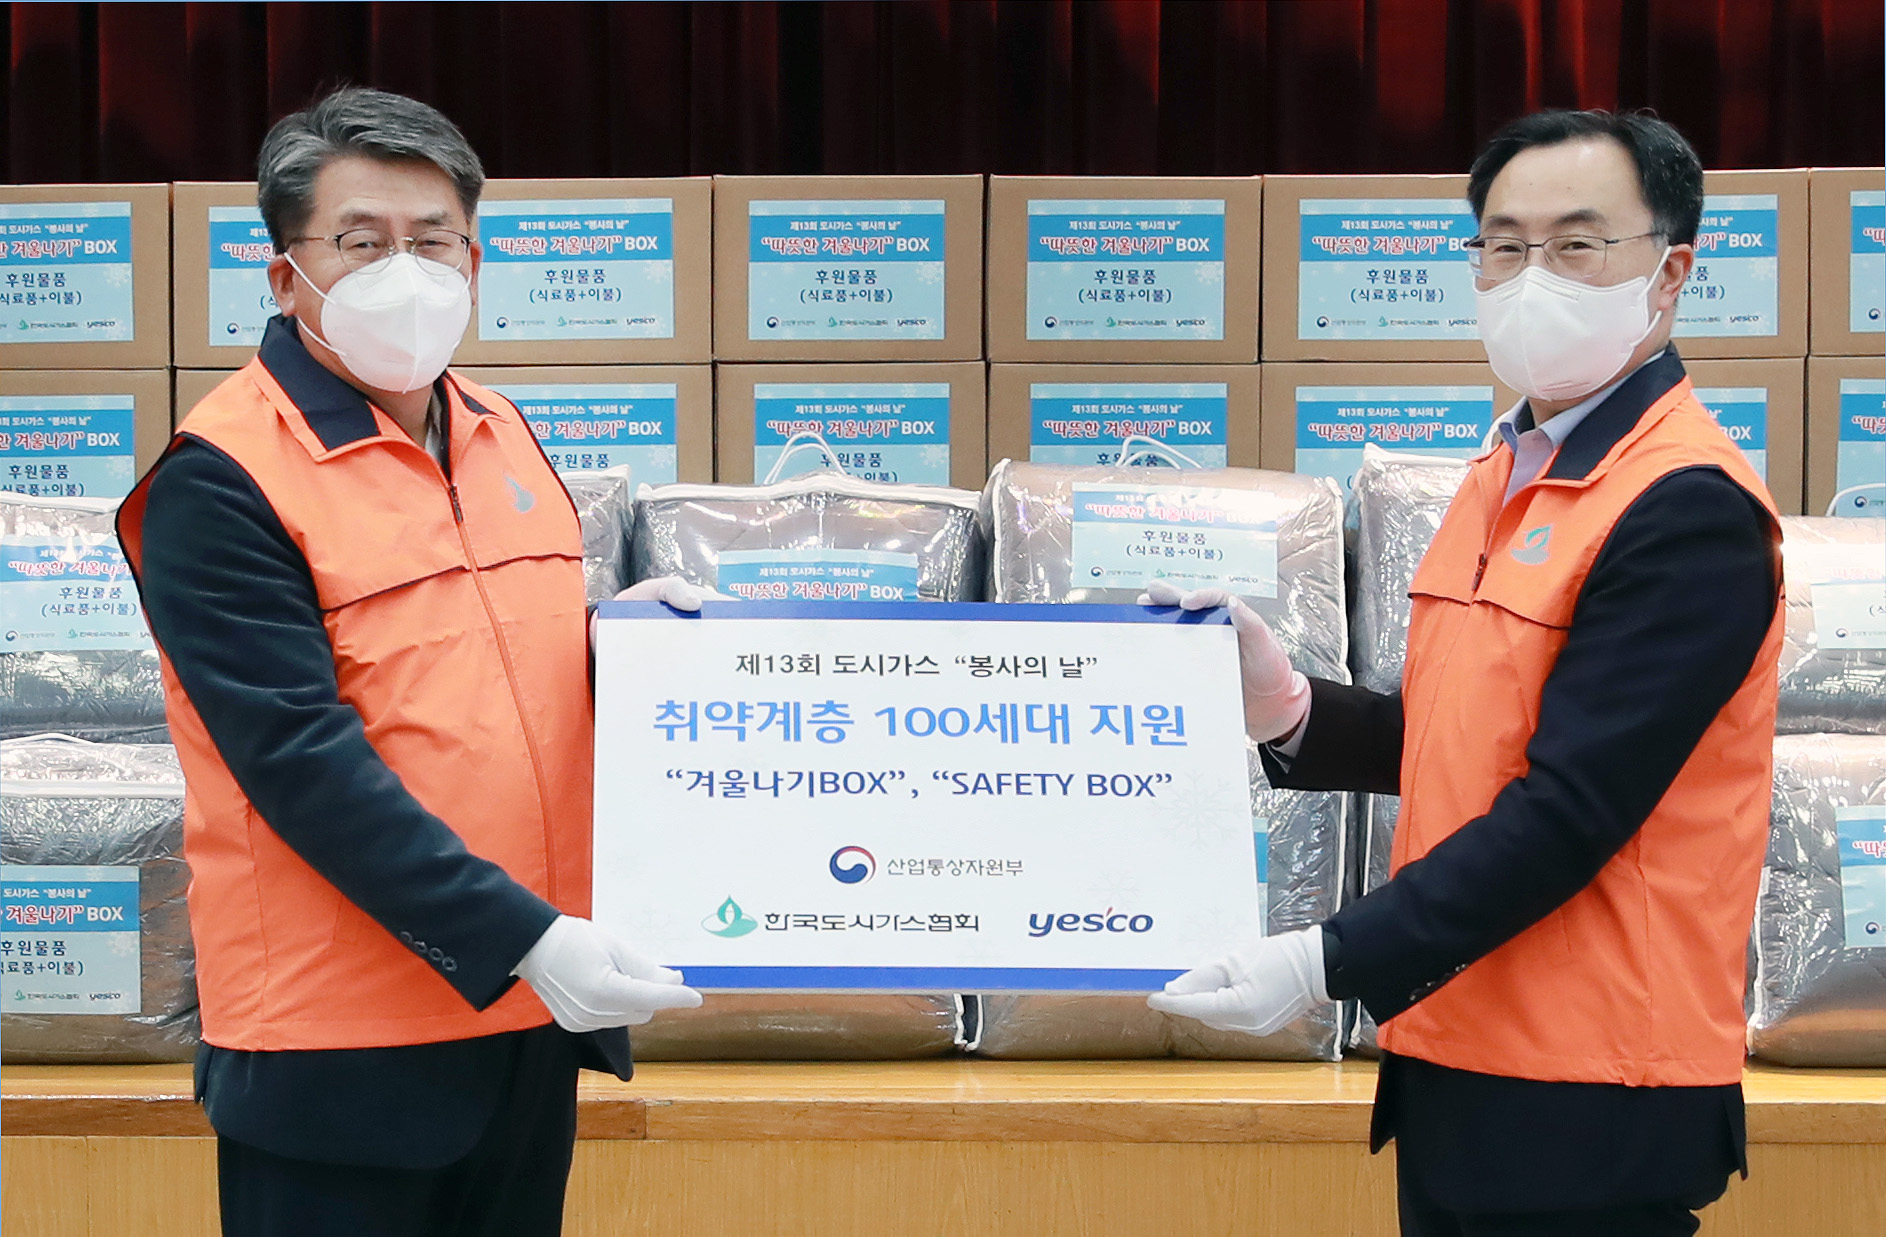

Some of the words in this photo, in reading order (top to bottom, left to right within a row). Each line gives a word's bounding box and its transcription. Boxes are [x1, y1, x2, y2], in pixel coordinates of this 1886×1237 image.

[250, 228, 269, 237] 제13
[490, 236, 547, 255] “따뜻한
[550, 236, 622, 254] 겨울나기”
[624, 236, 658, 250] BOX
[761, 237, 819, 255] “따뜻한
[822, 237, 893, 254] 겨울나기”
[896, 237, 930, 252] BOX
[1040, 236, 1098, 254] “따뜻한
[1101, 236, 1173, 254] 겨울나기”
[1176, 237, 1210, 252] BOX
[1312, 236, 1370, 254] “따뜻한
[1373, 236, 1445, 254] 겨울나기”
[1729, 233, 1763, 248] BOX
[12, 239, 82, 258] 겨울나기”
[85, 240, 118, 254] BOX
[6, 272, 66, 287] 후원물품
[544, 269, 606, 284] 후원물품
[815, 269, 877, 284] 후원물품
[1094, 269, 1156, 284] 후원물품
[1367, 269, 1428, 284] 후원물품
[0, 291, 82, 305] 식료품+이불)
[530, 288, 621, 303] (식료품+이불)
[800, 288, 893, 303] (식료품+이불)
[1079, 288, 1171, 303] (식료품+이불)
[1351, 288, 1444, 303] (식료품+이불)
[1682, 285, 1725, 300] +이불)
[554, 420, 626, 439] 겨울나기”
[629, 421, 662, 435] BOX
[828, 420, 899, 438] 겨울나기”
[901, 421, 935, 435] BOX
[1042, 420, 1100, 438] “따뜻한
[1104, 420, 1176, 437] 겨울나기”
[1179, 421, 1212, 435] BOX
[1308, 422, 1366, 441] “따뜻한
[1369, 422, 1441, 441] 겨울나기”
[1444, 424, 1478, 438] BOX
[15, 431, 85, 450] 겨울나기”
[87, 433, 120, 446] BOX
[550, 454, 609, 468] 후원물품
[8, 464, 69, 479] 후원물품
[1143, 530, 1206, 546] 후원물품
[1126, 544, 1224, 561] (식료품+이불)
[68, 561, 132, 576] 겨울나기
[59, 587, 122, 599] 후원물품
[729, 582, 788, 599] “따뜻한
[792, 582, 867, 600] 겨울나기”
[870, 585, 904, 600] BOX
[41, 603, 137, 617] (식료품+이불)
[736, 653, 821, 677] 제13회
[832, 654, 940, 677] 도시가스
[954, 655, 1048, 678] “봉사의
[1059, 656, 1098, 678] 날”
[653, 700, 855, 744] 취약계층
[874, 703, 1071, 745] 100세대
[1089, 704, 1188, 747] 지원
[666, 768, 919, 799] “겨울나기BOX”,
[932, 770, 1075, 797] “SAFETY
[1086, 771, 1172, 798] BOX”
[887, 858, 1024, 877] 산업통상자원부
[4, 888, 40, 898] 도시가스
[6, 905, 85, 924] 겨울나기”
[87, 906, 124, 922] BOX
[764, 912, 980, 932] 한국도시가스협회
[1, 940, 66, 956] 후원물품
[1, 961, 84, 976] 료품+이불)
